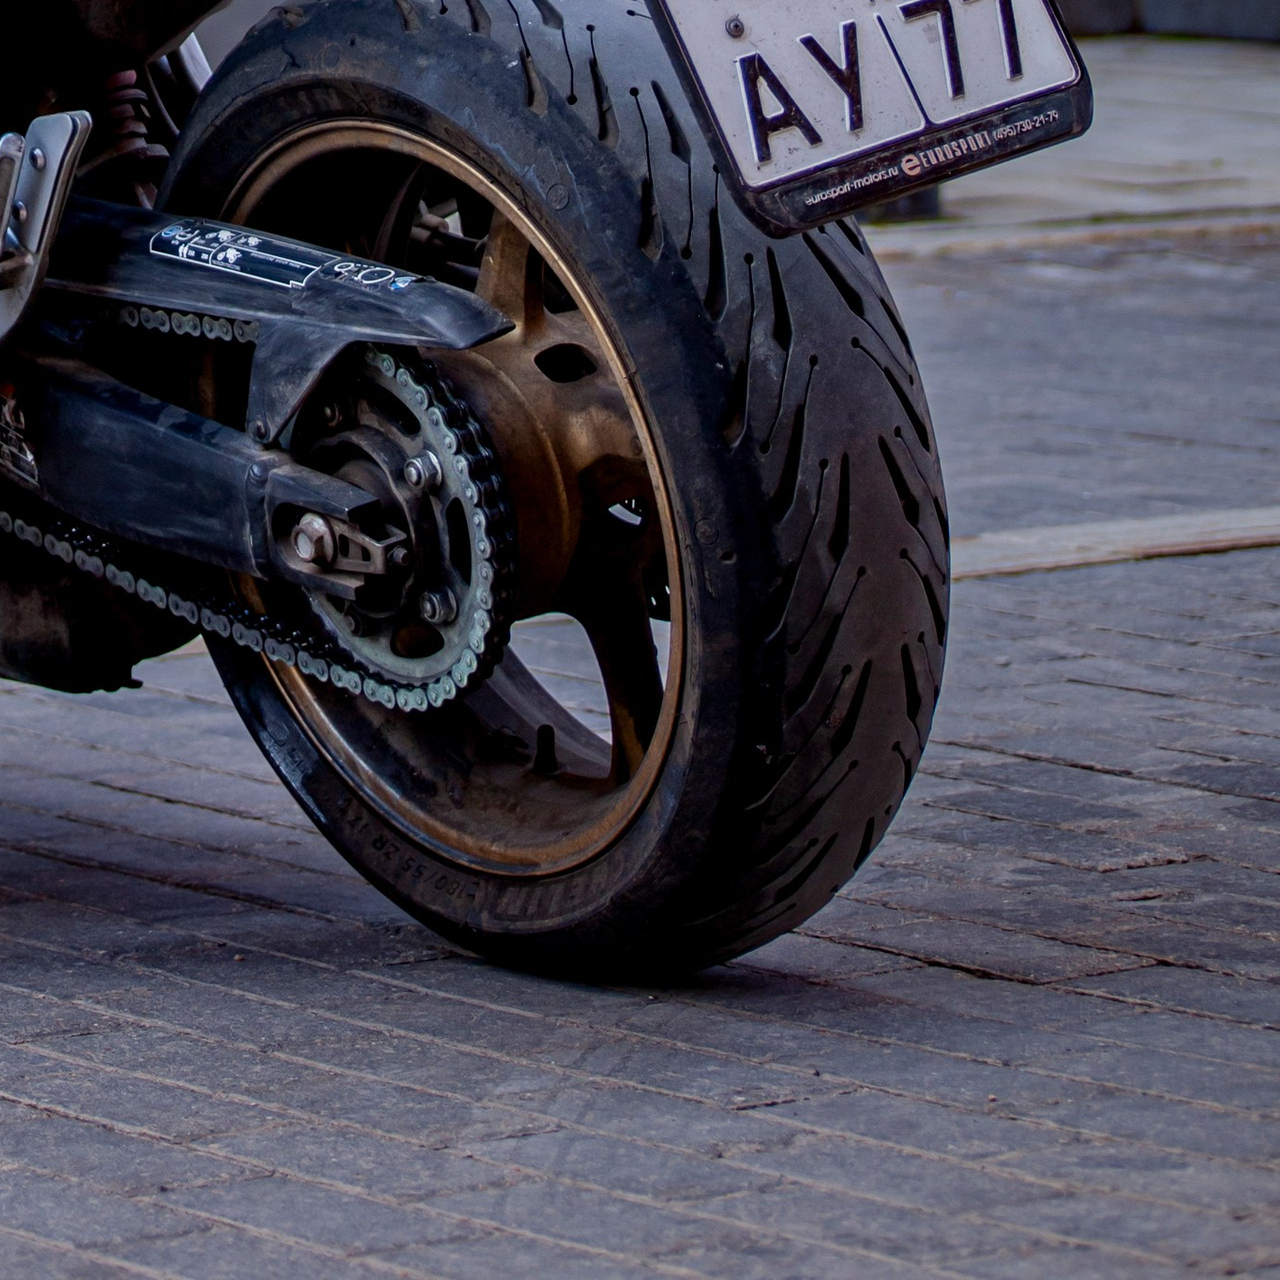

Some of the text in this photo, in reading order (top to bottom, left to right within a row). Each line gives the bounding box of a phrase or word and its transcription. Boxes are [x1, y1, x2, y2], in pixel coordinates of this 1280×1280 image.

[805, 166, 898, 206] eurosport-motors.ru
[921, 131, 992, 169] EUROSPORT
[993, 110, 1059, 142] (495)730-21-79
